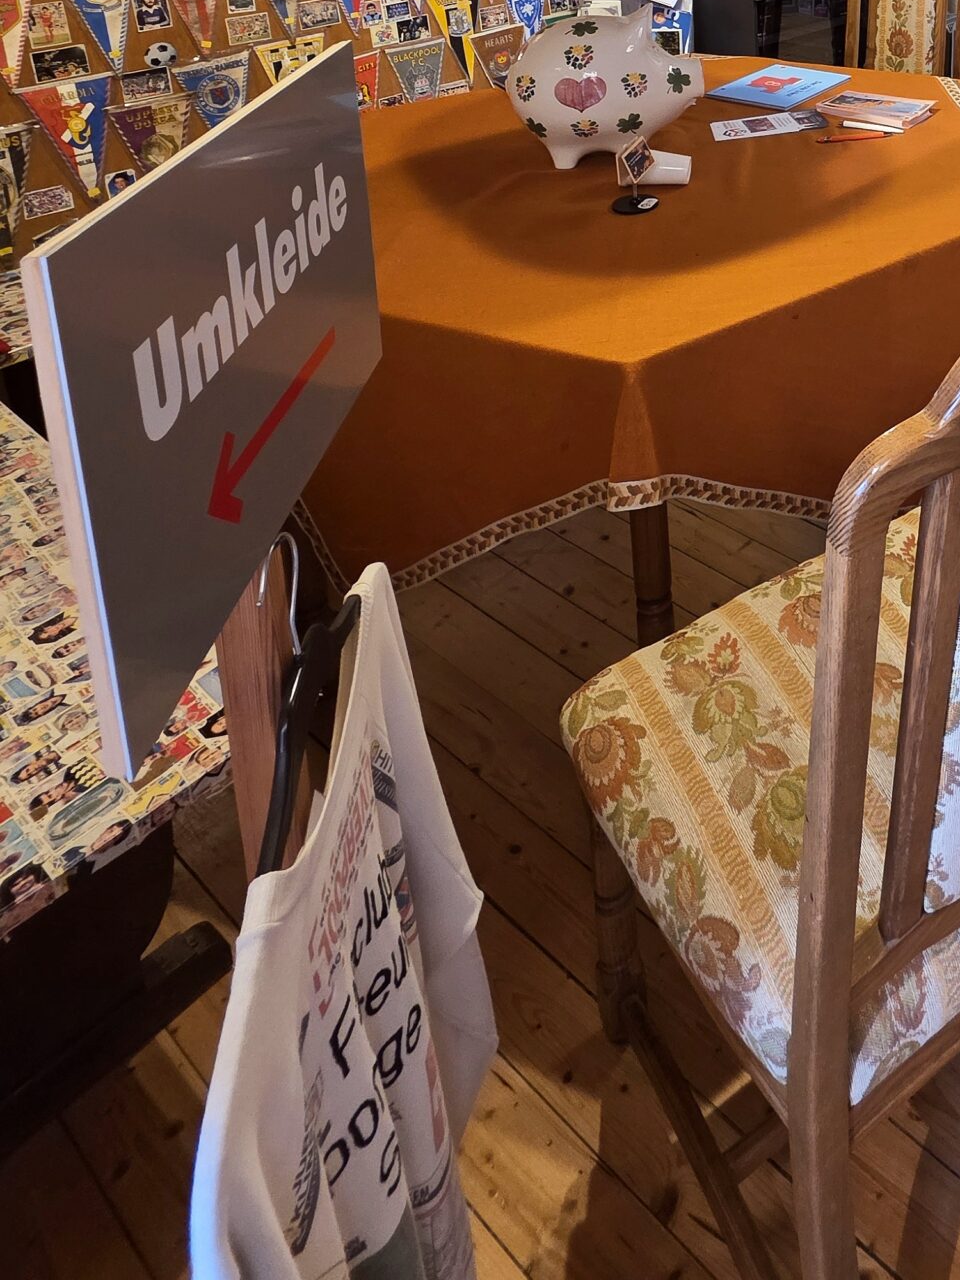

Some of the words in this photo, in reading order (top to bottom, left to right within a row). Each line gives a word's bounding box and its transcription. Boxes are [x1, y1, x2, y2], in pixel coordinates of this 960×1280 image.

[484, 33, 515, 48] HEARTS
[393, 45, 441, 64] BLACKPOOL
[358, 61, 377, 73] CITY
[132, 162, 347, 442] Umkleide
